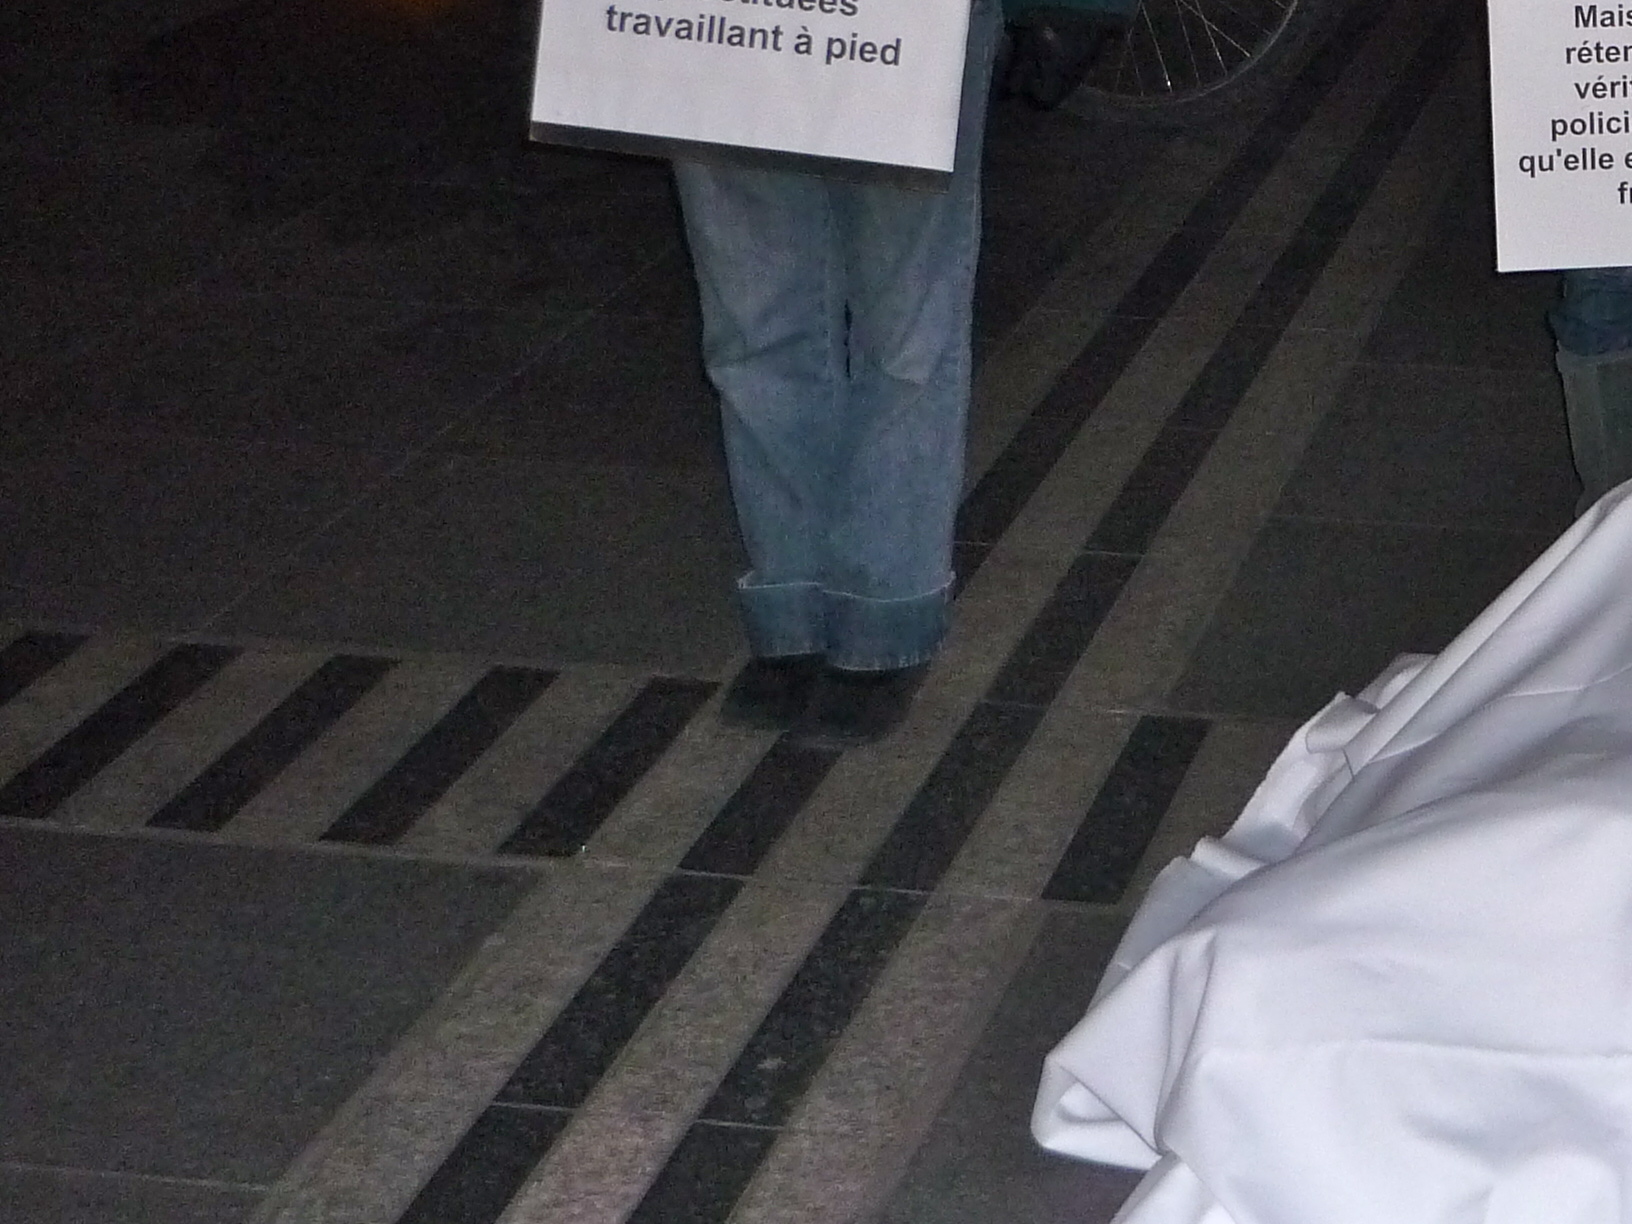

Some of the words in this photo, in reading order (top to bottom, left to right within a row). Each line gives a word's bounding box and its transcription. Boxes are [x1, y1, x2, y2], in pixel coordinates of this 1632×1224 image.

[605, 4, 784, 52] travaillant
[793, 25, 813, 56] à
[824, 32, 902, 67] pied
[1518, 146, 1615, 179] qu'elle
